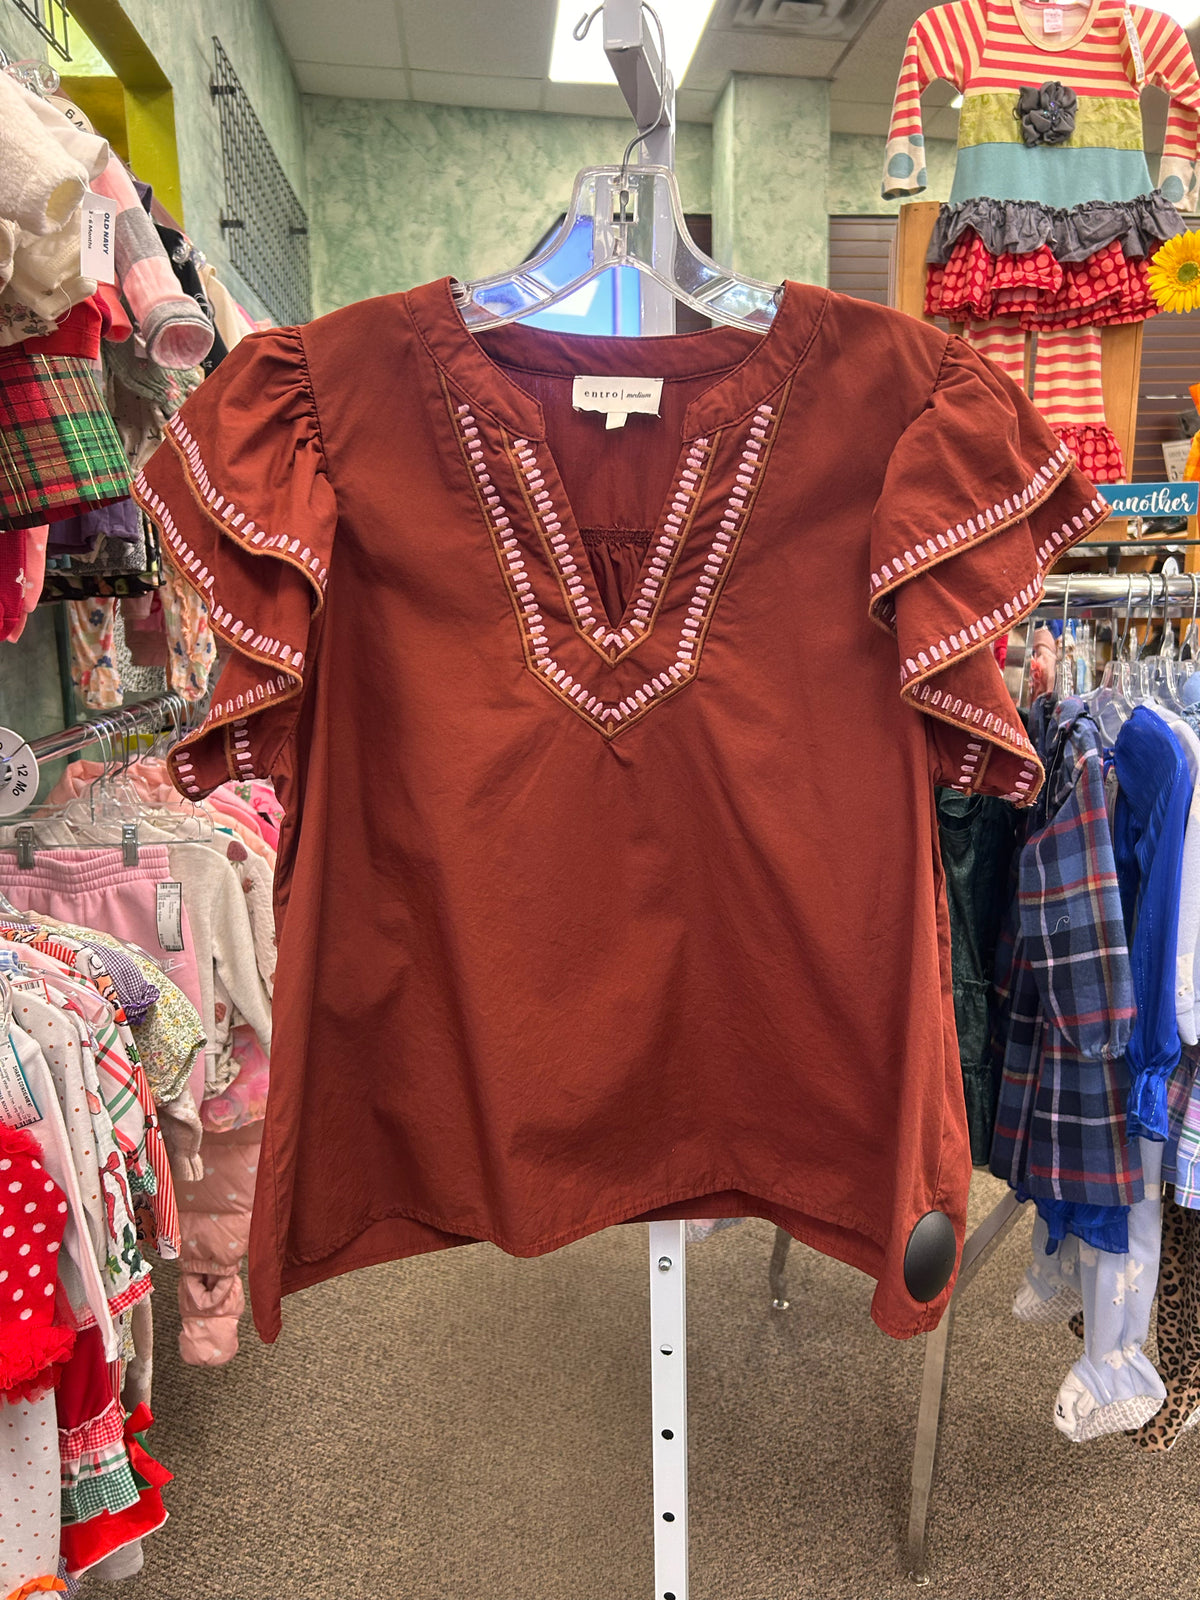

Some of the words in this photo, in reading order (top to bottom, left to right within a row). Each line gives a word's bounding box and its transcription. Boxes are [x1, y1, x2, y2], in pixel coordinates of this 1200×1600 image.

[584, 390, 618, 399] entro
[626, 391, 652, 399] medium
[1112, 487, 1195, 513] another
[17, 764, 29, 777] 12
[12, 780, 28, 797] Mo
